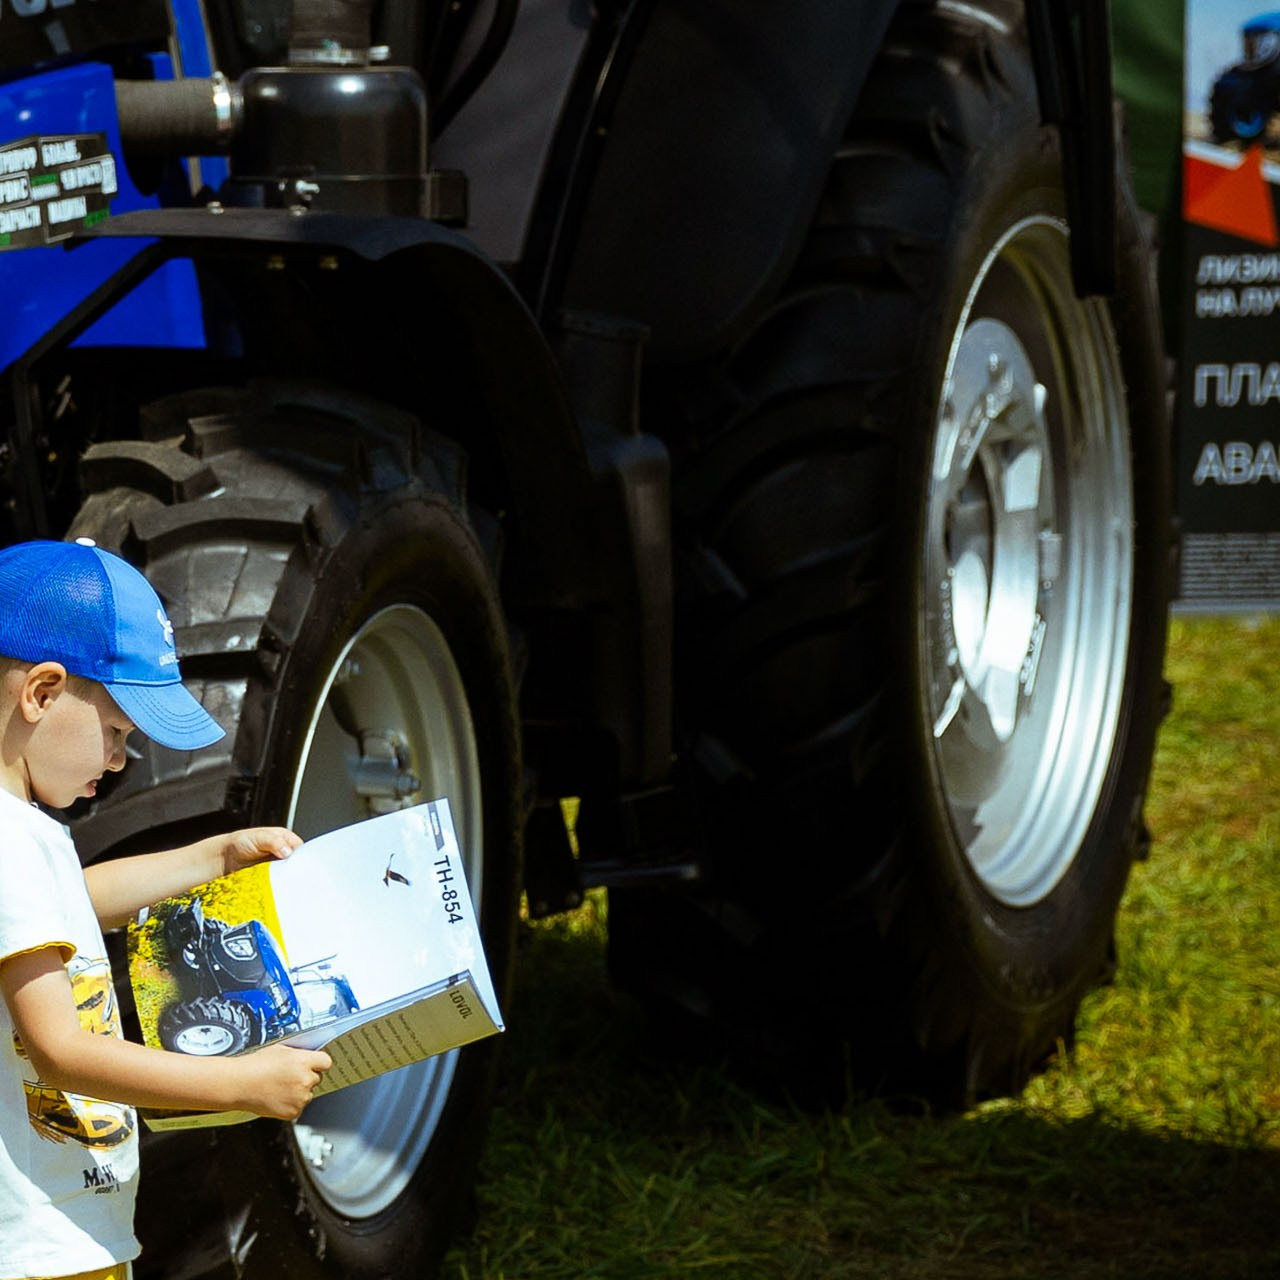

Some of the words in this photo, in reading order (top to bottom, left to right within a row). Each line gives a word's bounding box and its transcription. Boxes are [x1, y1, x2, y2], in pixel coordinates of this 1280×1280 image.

[1197, 254, 1280, 285] ЛИЗИ
[1195, 288, 1237, 318] НА
[1239, 287, 1280, 317] ЛУ
[1193, 441, 1280, 486] АВА
[434, 854, 464, 924] TH-854
[449, 990, 473, 1020] LOVOL
